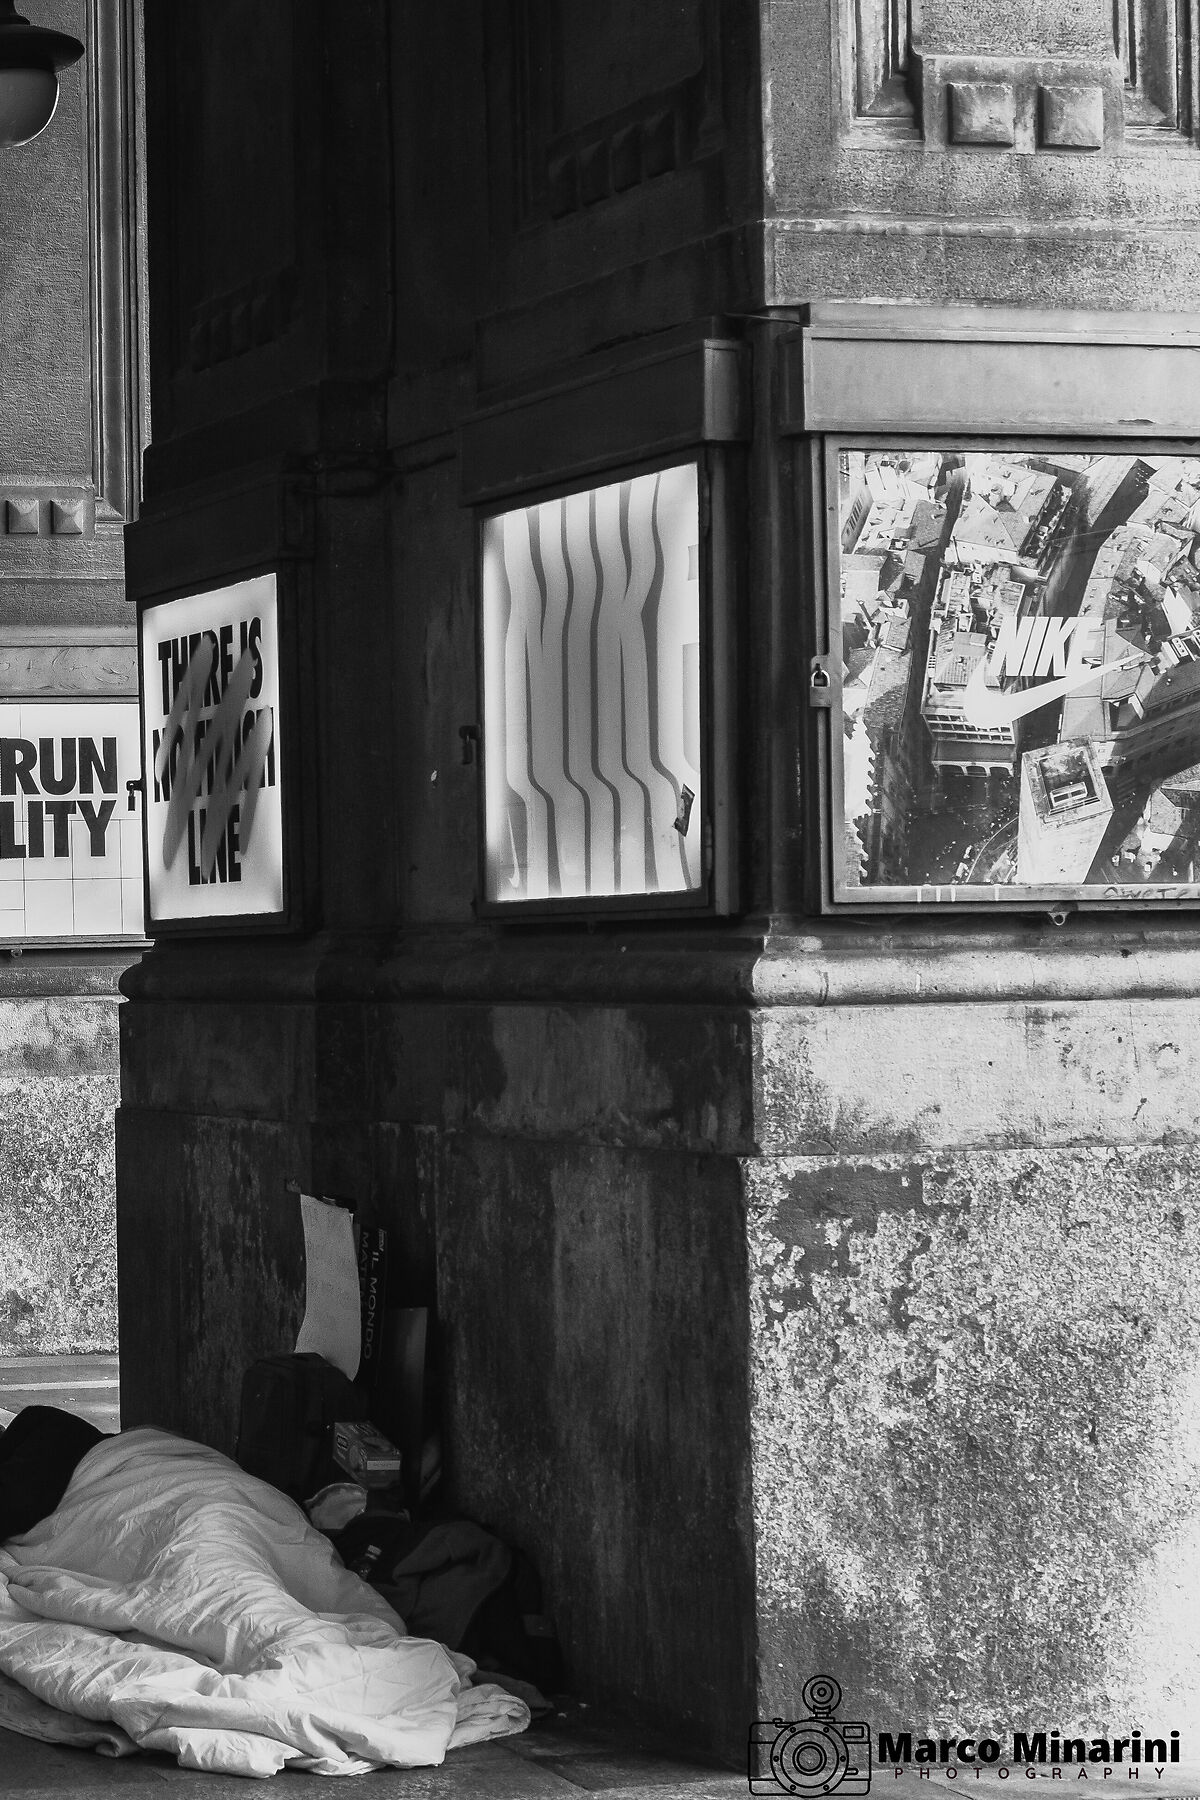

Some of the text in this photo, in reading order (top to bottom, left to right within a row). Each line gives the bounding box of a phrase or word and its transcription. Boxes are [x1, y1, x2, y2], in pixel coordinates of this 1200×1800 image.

[157, 624, 233, 716] THRE
[987, 616, 1104, 676] NIKE
[364, 1277, 378, 1359] MONDO
